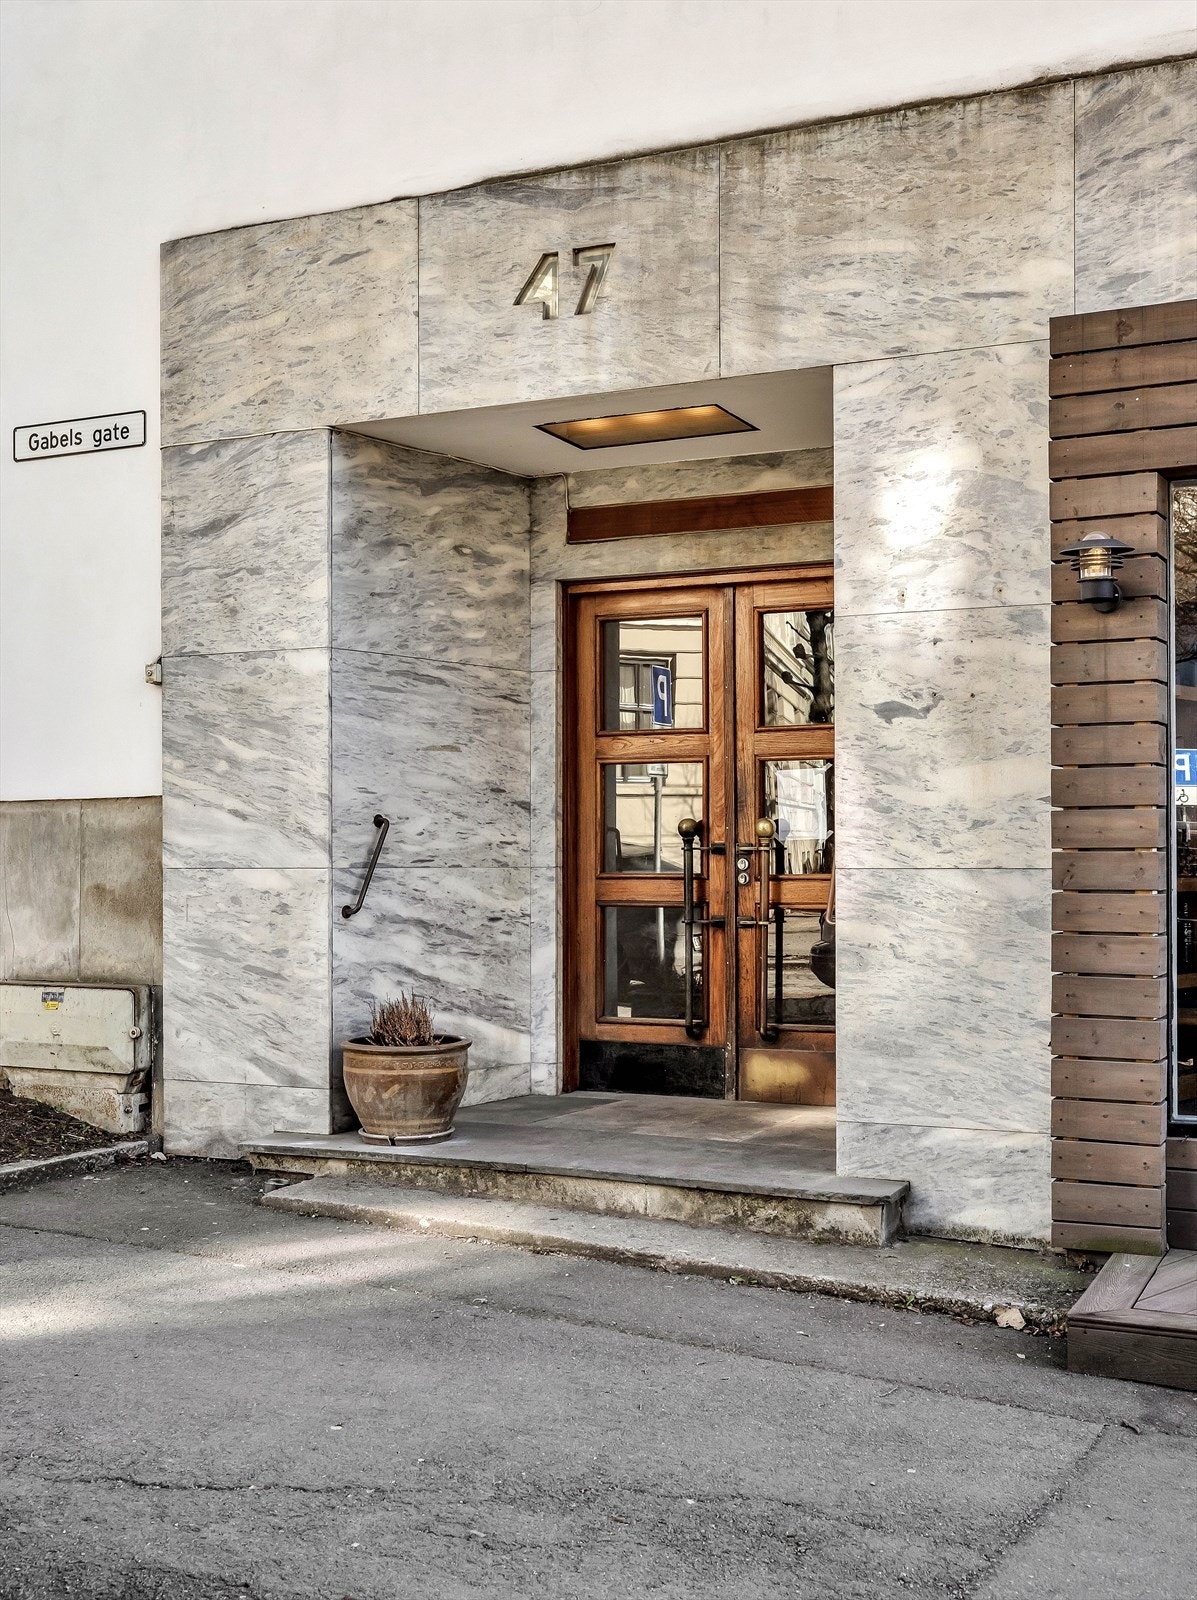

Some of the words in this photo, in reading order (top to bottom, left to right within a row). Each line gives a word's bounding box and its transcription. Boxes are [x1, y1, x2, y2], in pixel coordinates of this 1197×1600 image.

[513, 243, 616, 320] 47
[28, 428, 83, 451] Gabels
[92, 423, 130, 447] gate
